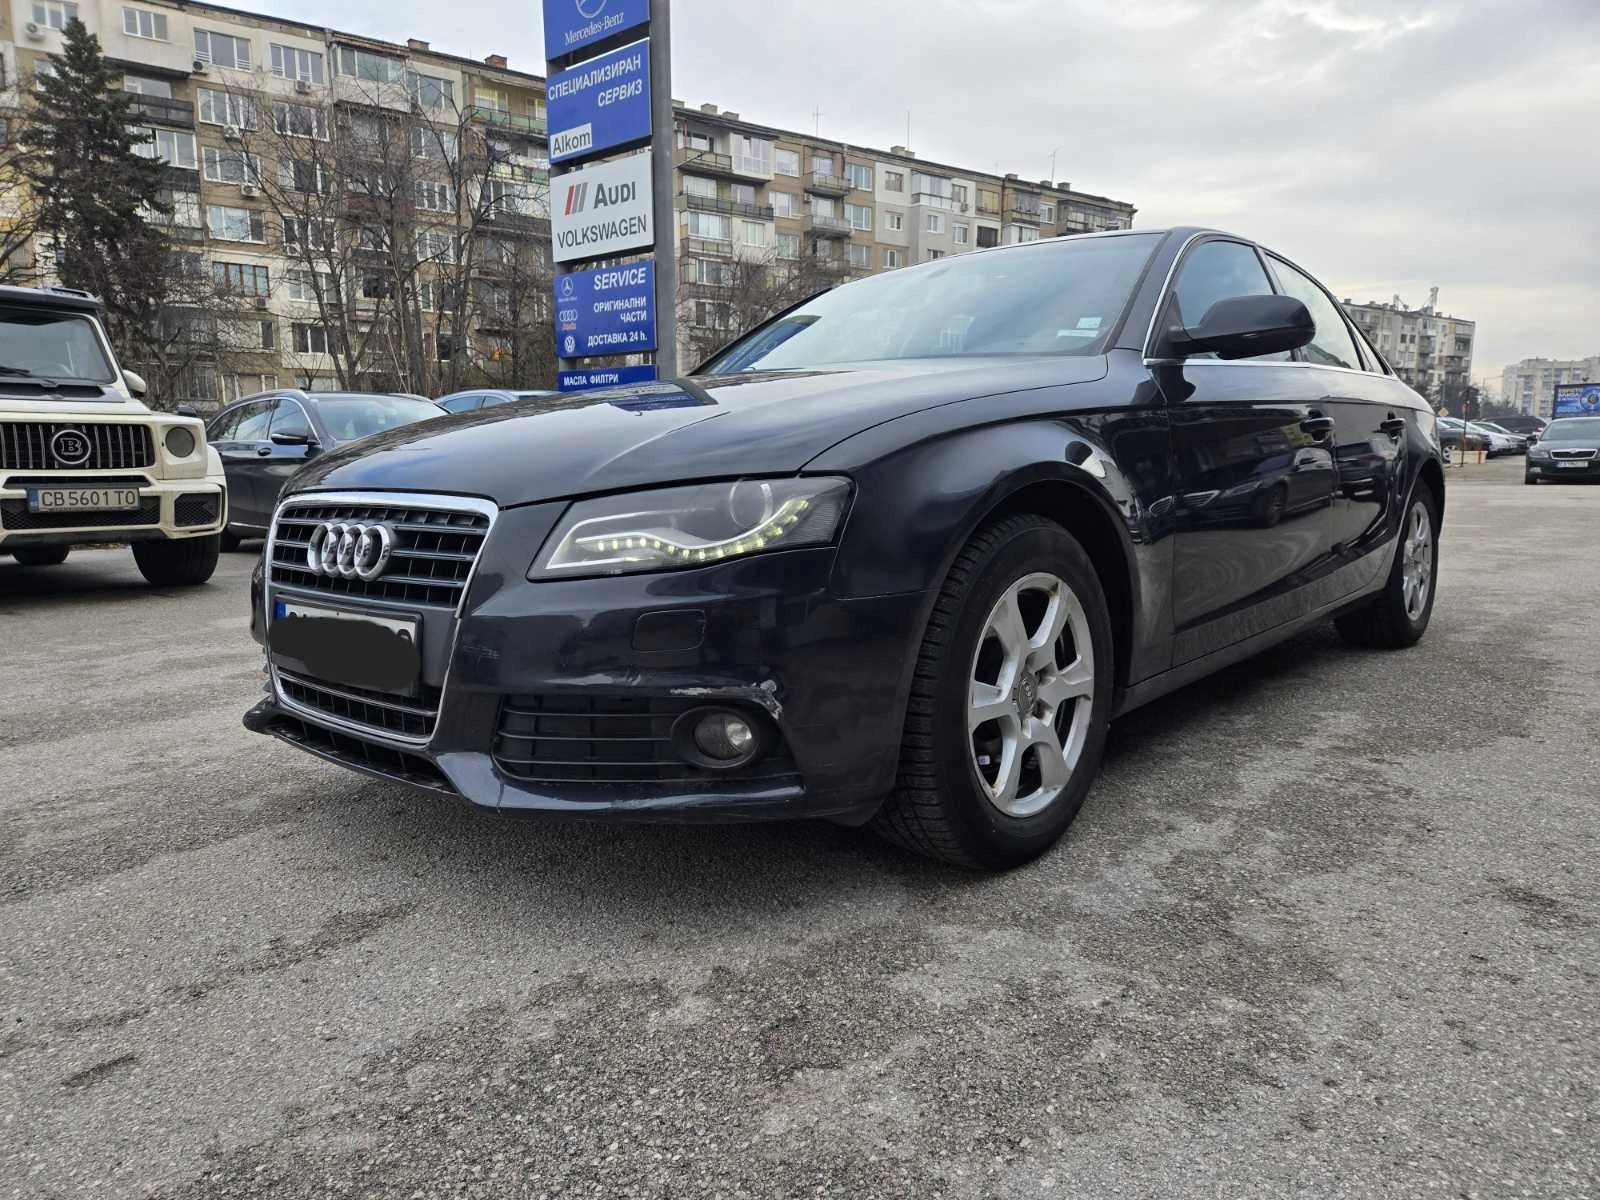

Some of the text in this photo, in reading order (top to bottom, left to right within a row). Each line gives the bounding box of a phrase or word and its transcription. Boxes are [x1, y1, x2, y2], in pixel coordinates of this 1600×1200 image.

[565, 12, 624, 45] Mercedes-Benz
[548, 54, 641, 101] СПЕЦИАЛИЗИРАН
[598, 79, 642, 107] СЕРВИЗ
[553, 131, 590, 155] Alkom
[557, 214, 647, 248] VOLKSWAGEN
[594, 267, 646, 290] SERVICE
[593, 296, 646, 312] ОРИГИНАЛНИ
[620, 310, 647, 323] ЧАСТИ
[587, 331, 647, 347] ДОСТАВКА 24 h.
[563, 374, 619, 386] МАСЛА ФИЛТРИ
[68, 490, 109, 506] 5601
